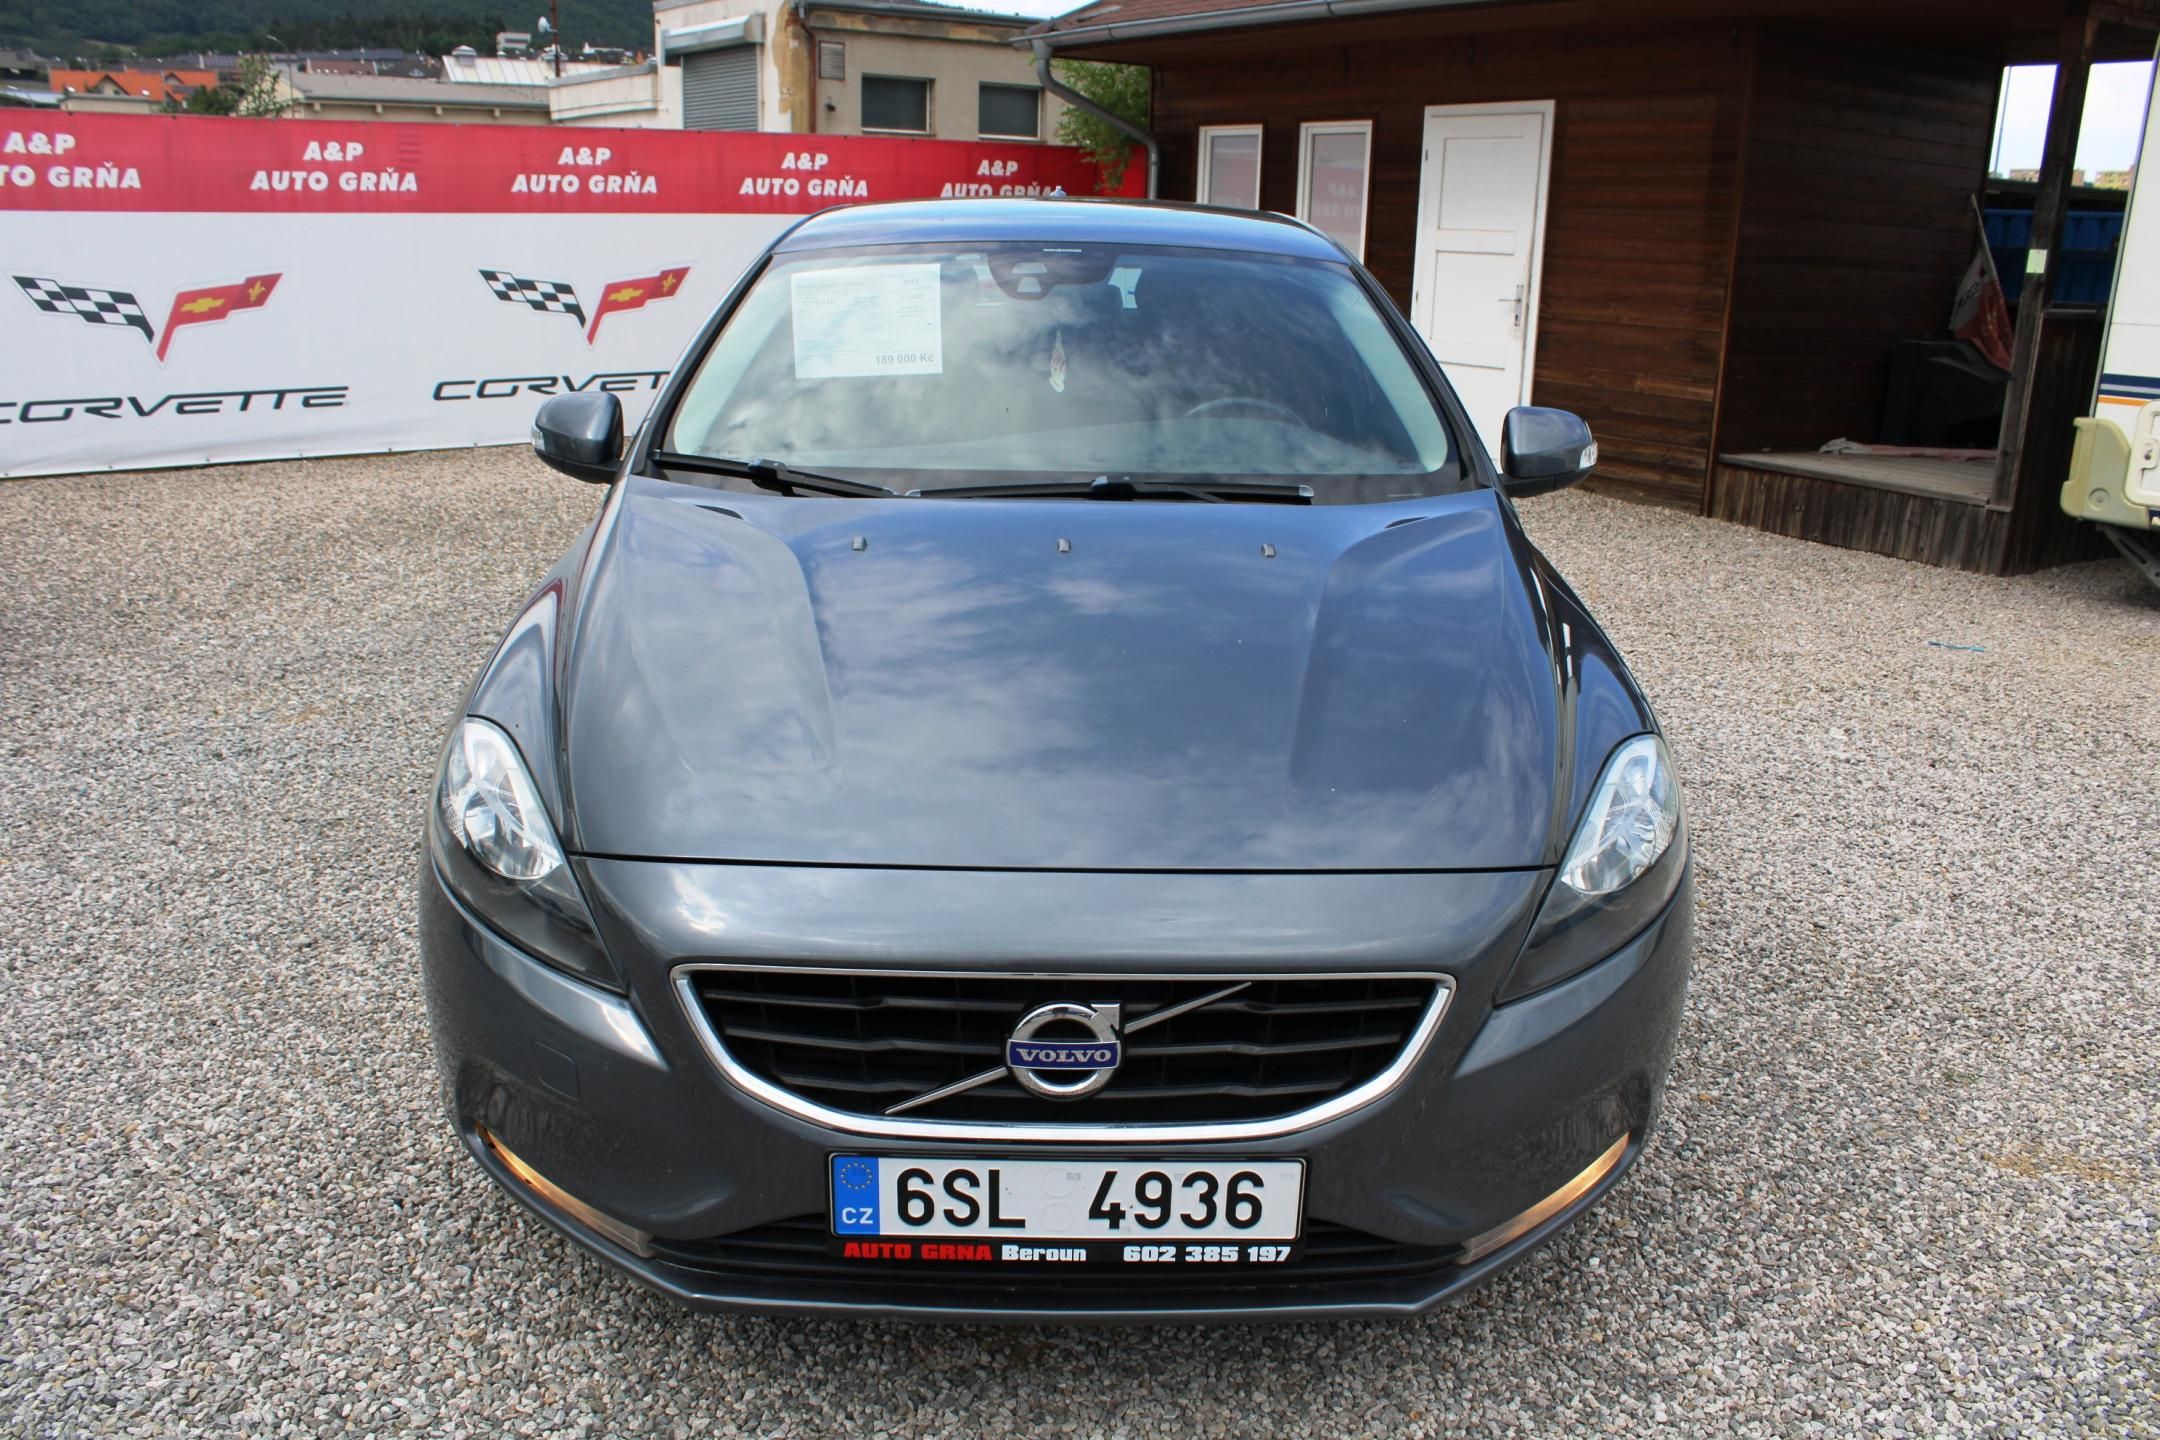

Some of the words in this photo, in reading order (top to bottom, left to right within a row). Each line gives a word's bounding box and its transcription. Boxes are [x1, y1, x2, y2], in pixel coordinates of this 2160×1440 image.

[3, 131, 76, 155] A&P
[303, 141, 364, 161] A&P
[557, 147, 612, 165] A&P
[781, 152, 829, 170] A&P
[0, 164, 36, 187] TO
[47, 161, 142, 189] GRŇA
[976, 159, 1019, 176] A&P
[250, 170, 329, 191] AUTO
[338, 167, 418, 191] GRŇA
[511, 174, 580, 193] AUTO
[588, 170, 658, 194] GRŇA
[739, 177, 800, 195] AUTO
[807, 175, 868, 196] GRŇA
[940, 182, 993, 197] AUTO
[876, 354, 894, 366] 189
[897, 353, 917, 365] 000
[920, 351, 934, 363] Kč
[432, 371, 670, 400] CORVET
[1016, 1048, 1112, 1063] VOLVO
[897, 1168, 1026, 1228] 6SL
[1089, 1170, 1264, 1229] 4936
[841, 1207, 873, 1224] CZ
[844, 1242, 911, 1259] AUTO
[921, 1244, 992, 1260] GRNA
[1001, 1244, 1087, 1261] Beroun
[1123, 1246, 1176, 1262] 602
[1185, 1246, 1239, 1262] 385
[1247, 1246, 1291, 1262] 197
